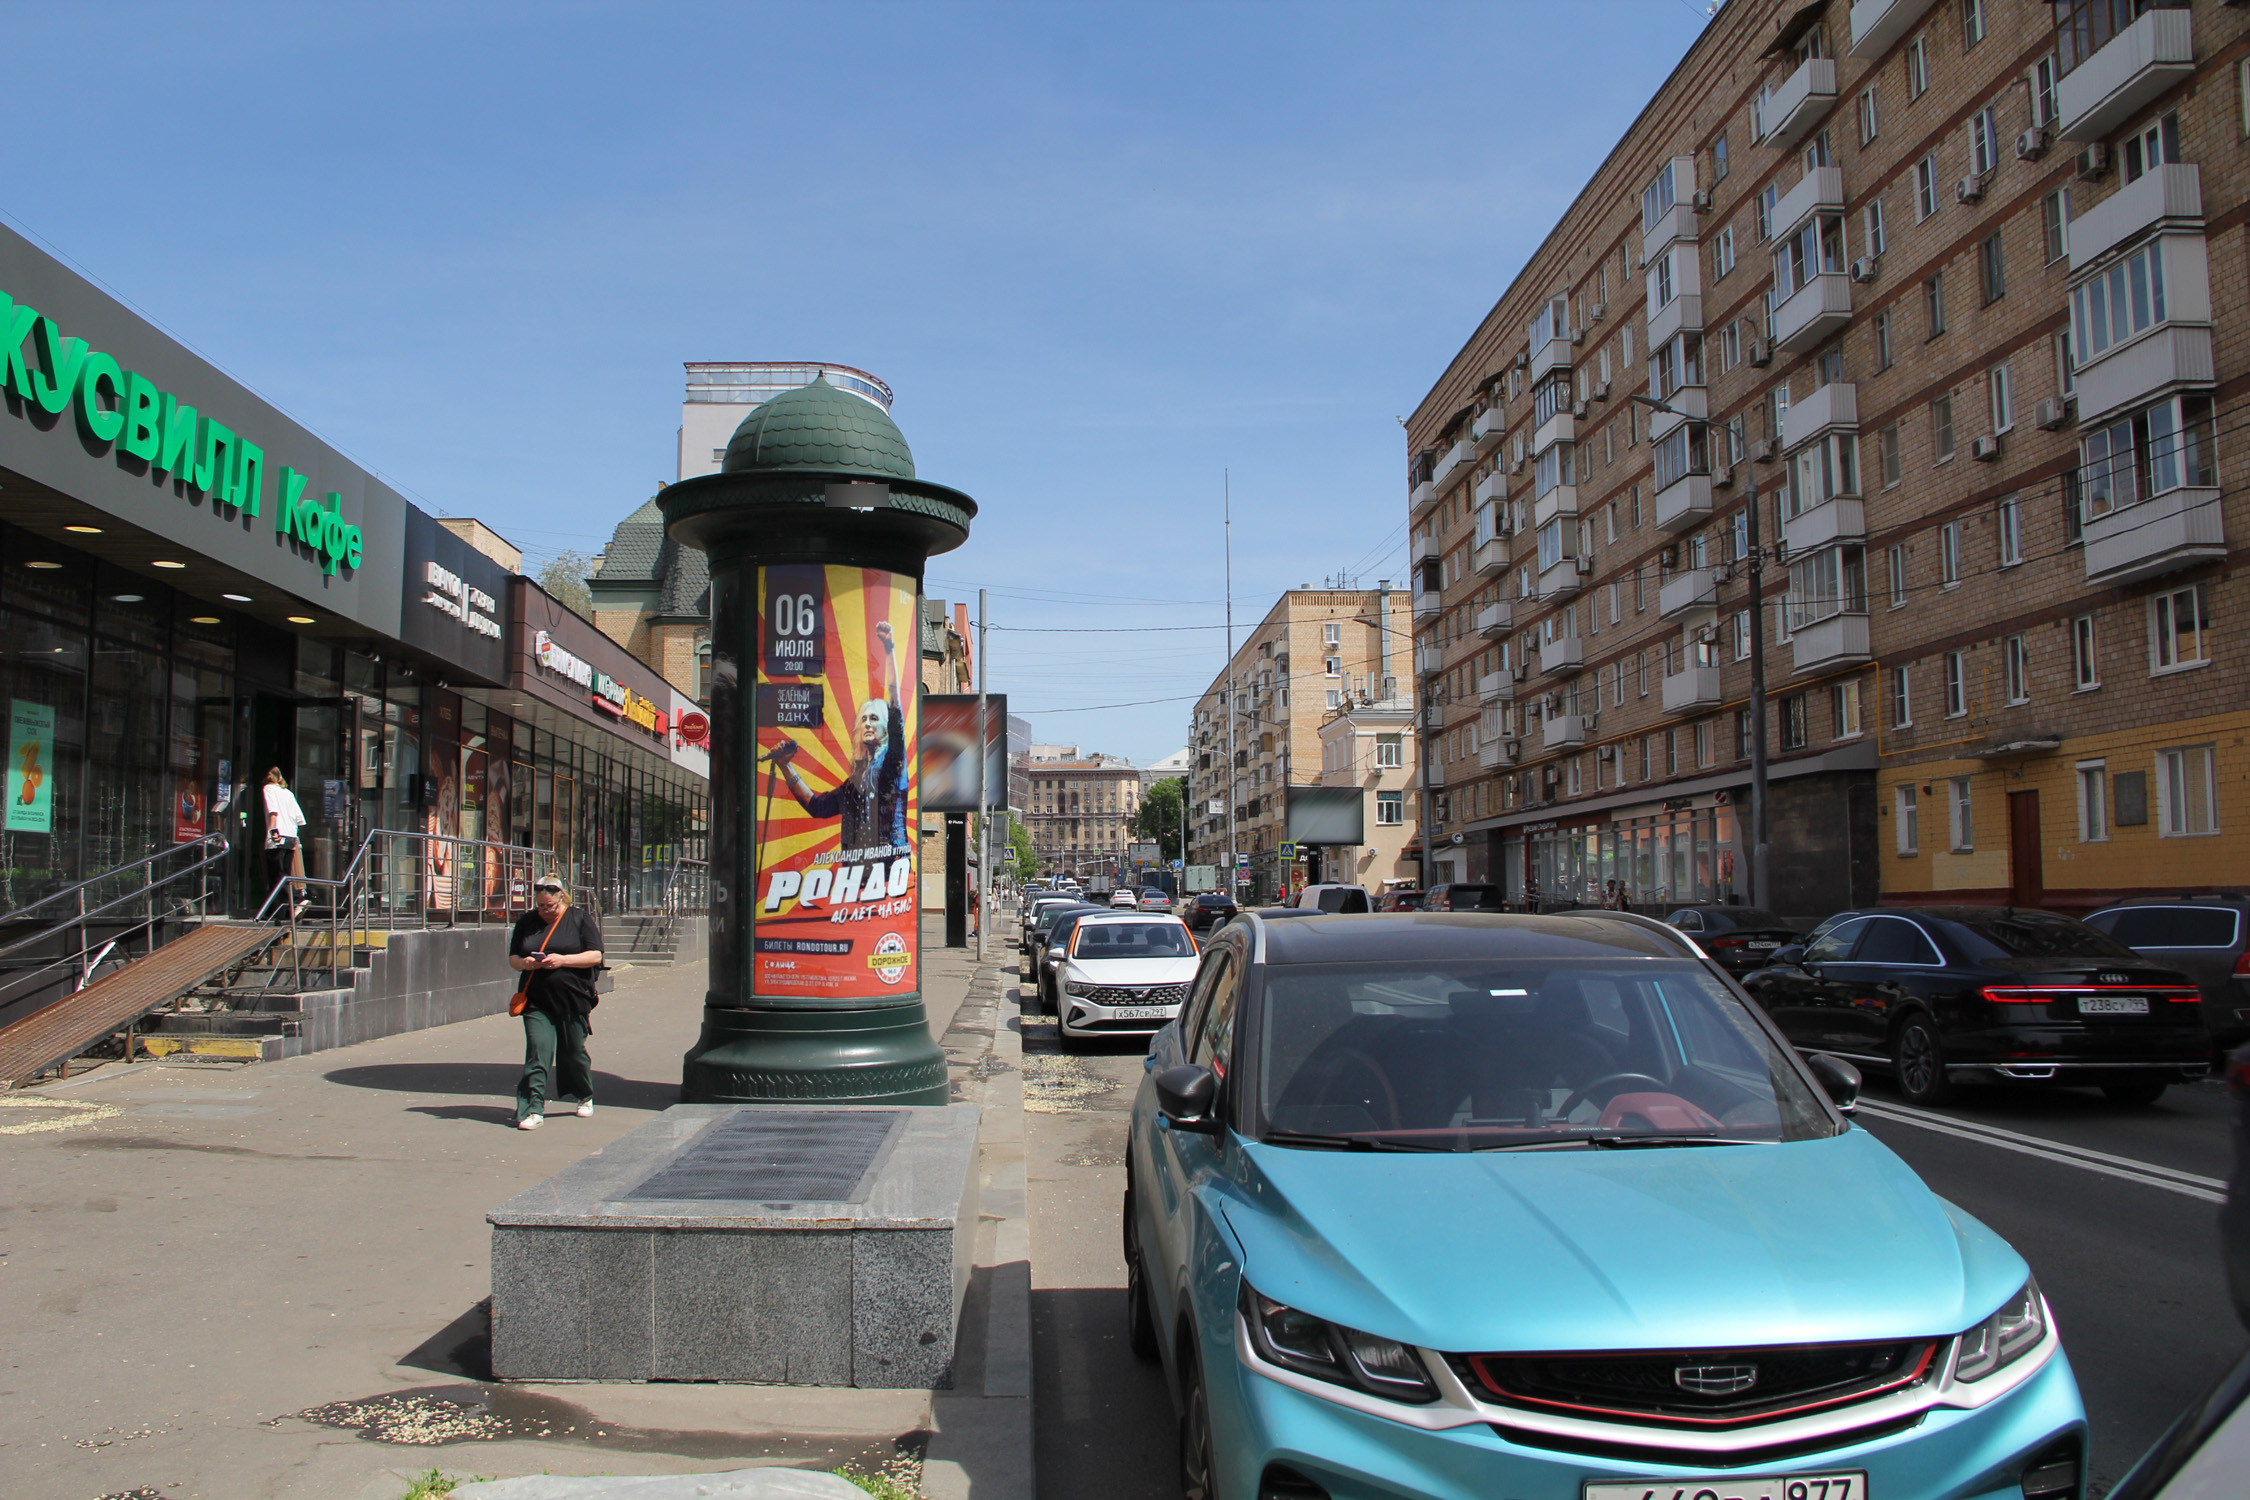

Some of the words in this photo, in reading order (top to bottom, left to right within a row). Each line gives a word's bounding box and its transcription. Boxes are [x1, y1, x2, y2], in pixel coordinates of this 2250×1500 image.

[276, 466, 362, 577] Кафе
[775, 593, 814, 636] 06
[776, 640, 813, 658] ИЮЛЯ
[784, 661, 803, 671] 20:00
[777, 687, 810, 703] ЗЕЛЁНЫЙ
[778, 702, 810, 710] ТЕАТР
[777, 712, 810, 723] ВДНХ
[813, 849, 862, 864] АЛЕКСАНДР
[864, 845, 892, 860] ИВАНОВ
[765, 858, 911, 911] РОНДО
[831, 908, 848, 924] 40
[850, 904, 877, 921] ЛЕТ
[877, 903, 892, 918] НА
[893, 897, 912, 914] БИС
[764, 940, 793, 951] БИЛЕТЫ
[796, 941, 849, 953] RONDOTOUR.RU
